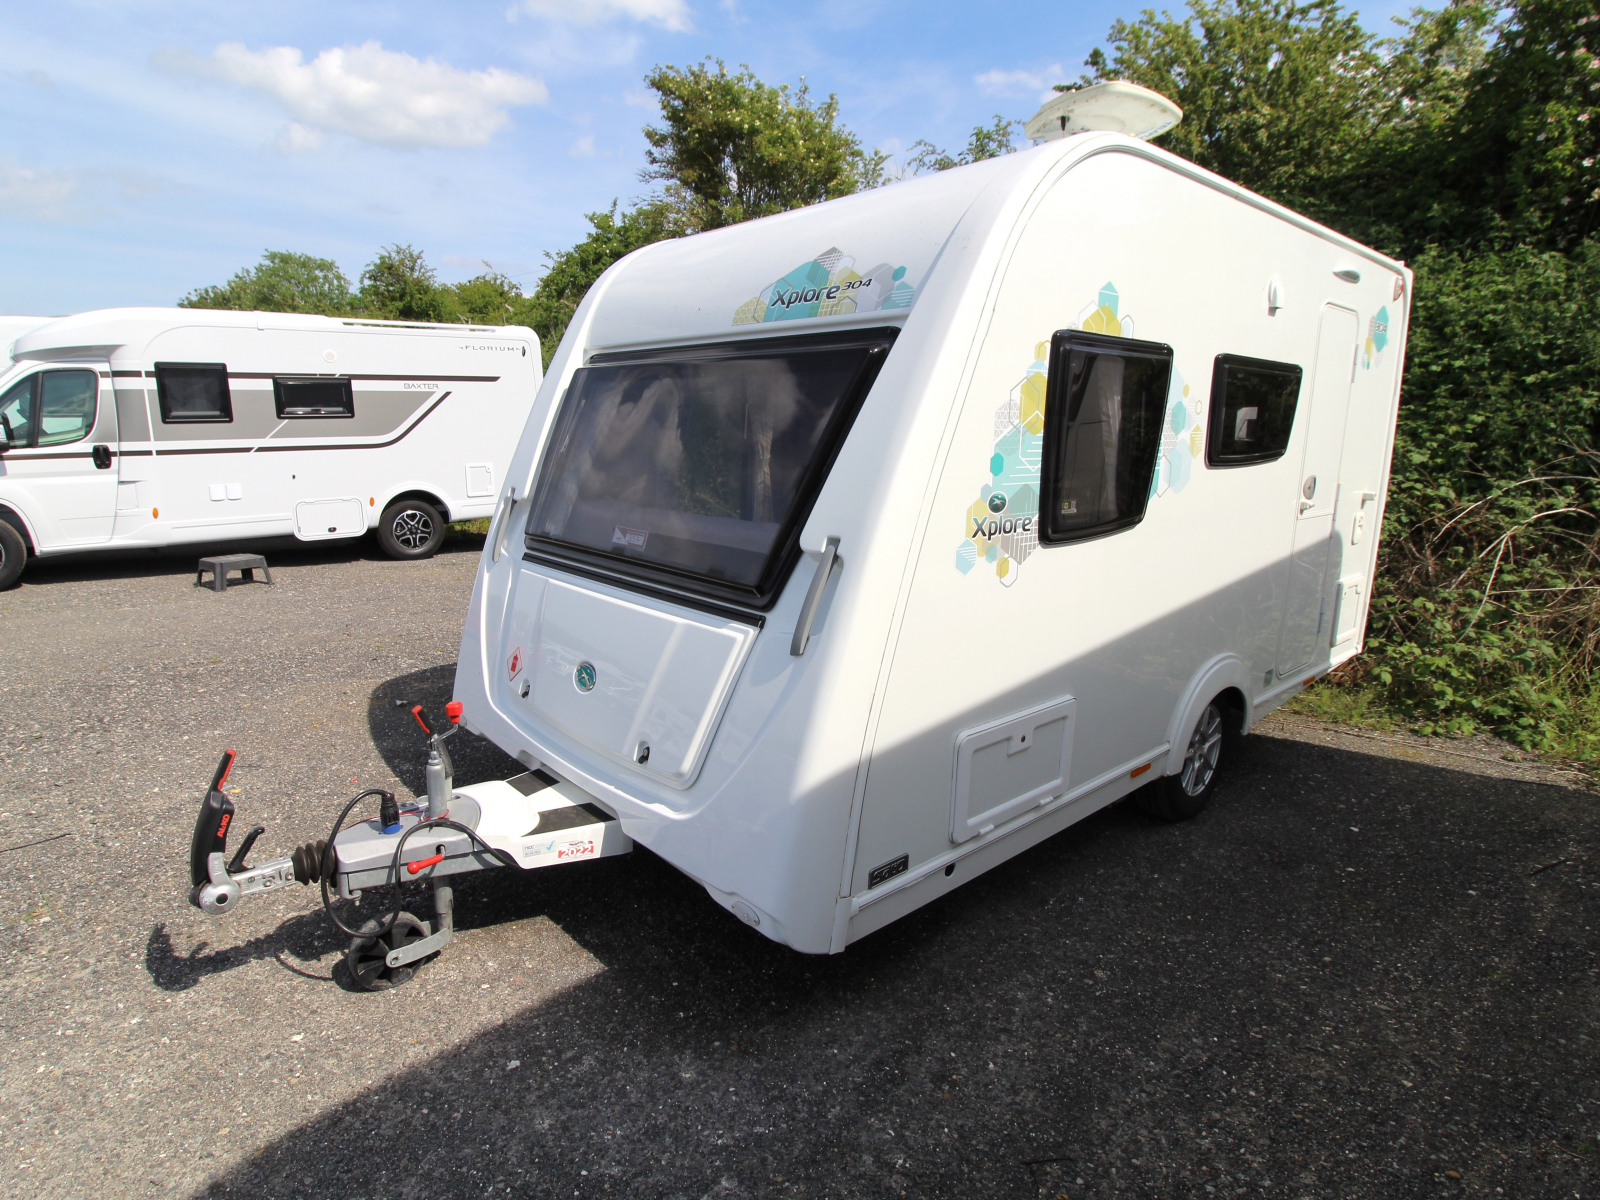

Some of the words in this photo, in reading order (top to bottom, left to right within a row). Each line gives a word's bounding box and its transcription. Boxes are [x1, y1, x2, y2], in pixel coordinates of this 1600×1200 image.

[770, 285, 841, 309] Xplore
[841, 278, 872, 291] 304
[403, 382, 440, 390] BAXTER
[971, 515, 1033, 541] Xplore
[560, 845, 593, 858] 2022
